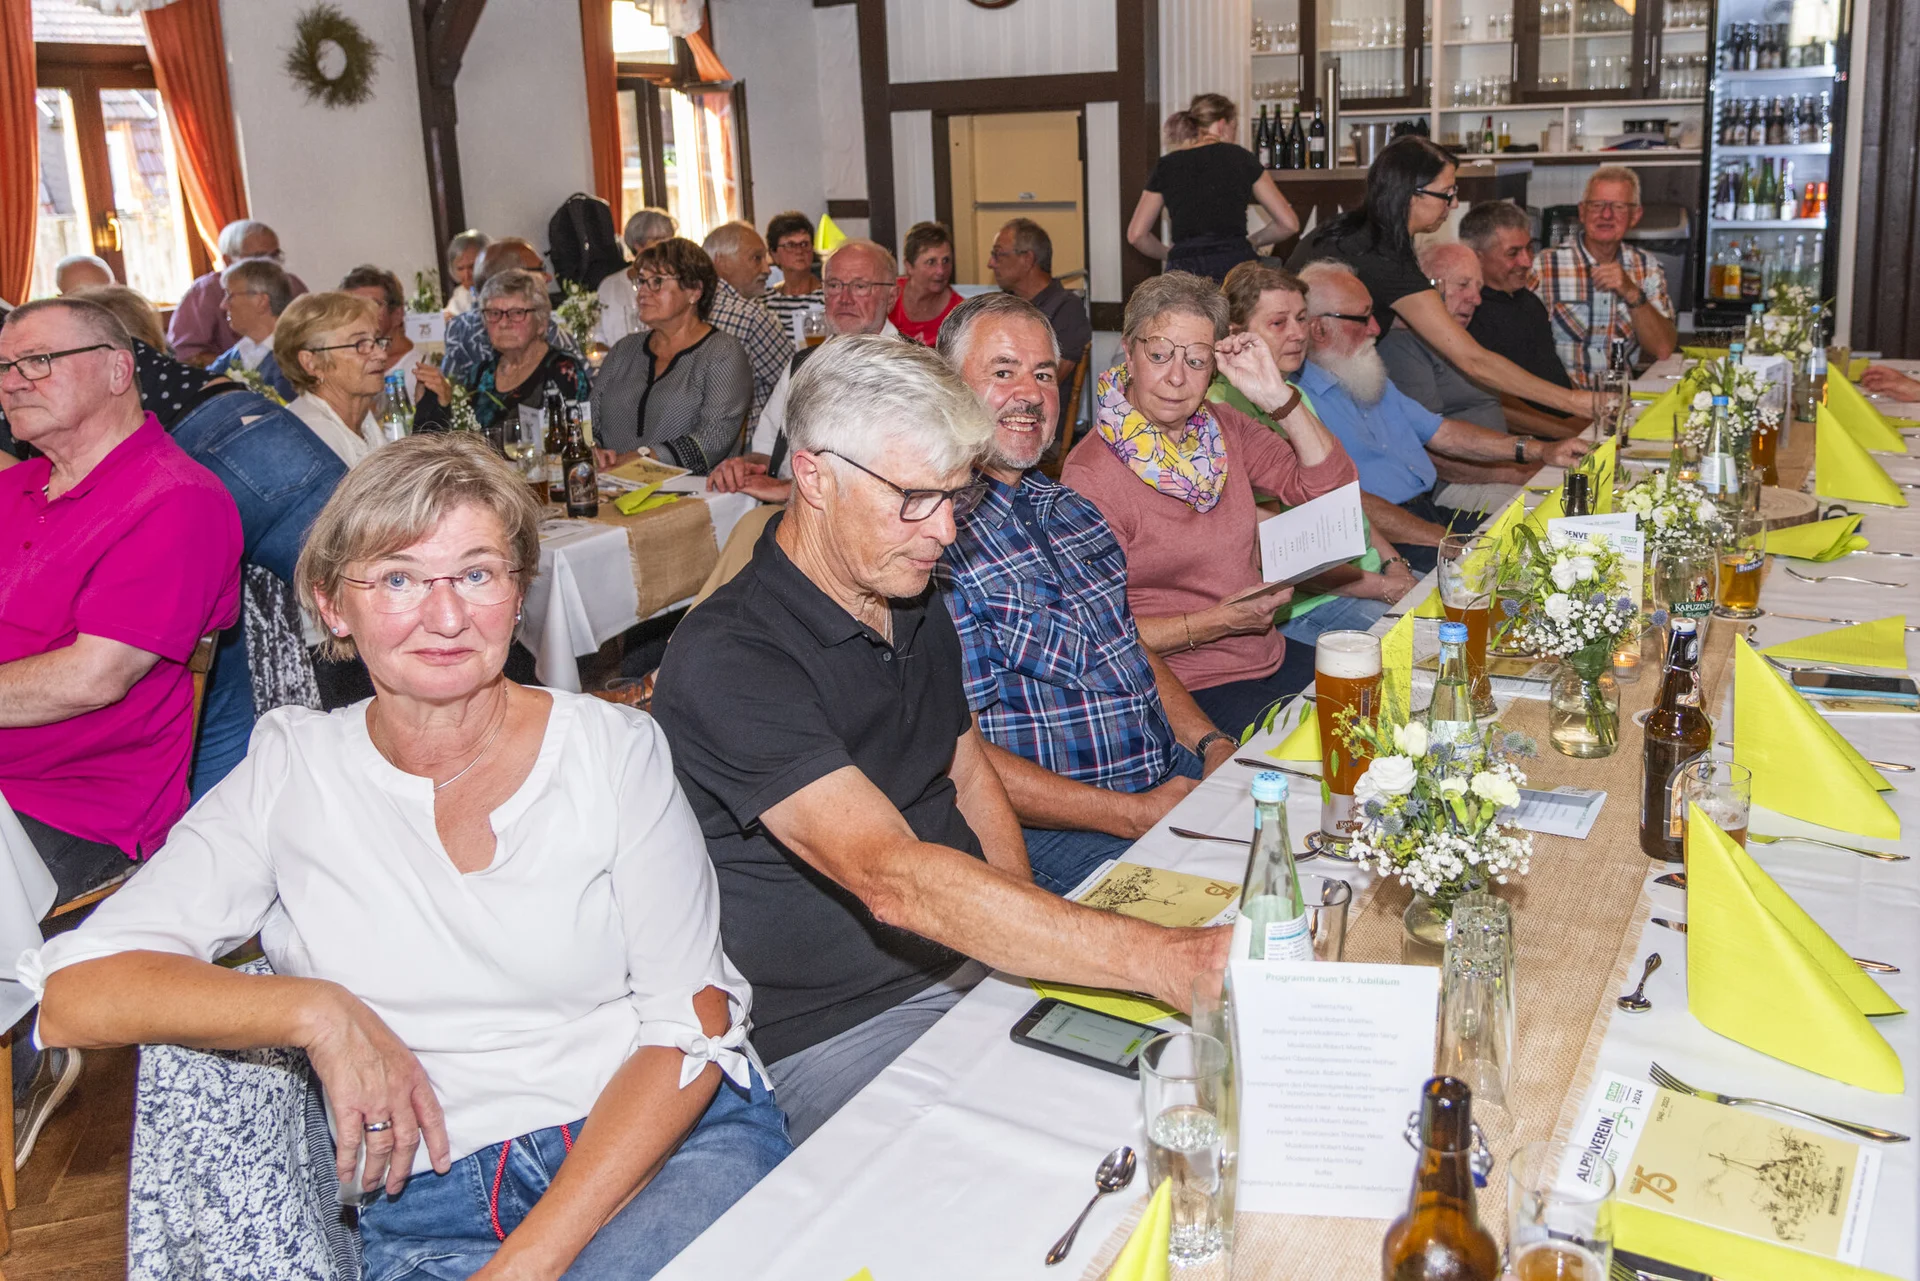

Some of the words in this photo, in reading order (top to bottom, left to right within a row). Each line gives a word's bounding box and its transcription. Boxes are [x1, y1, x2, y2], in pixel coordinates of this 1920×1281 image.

[1265, 973, 1315, 984] Programm
[1317, 975, 1338, 983] zum
[1340, 975, 1355, 984] 75.
[1356, 975, 1400, 986] Jubiläum
[1632, 1089, 1643, 1105] 2024
[1632, 1164, 1678, 1204] 75
